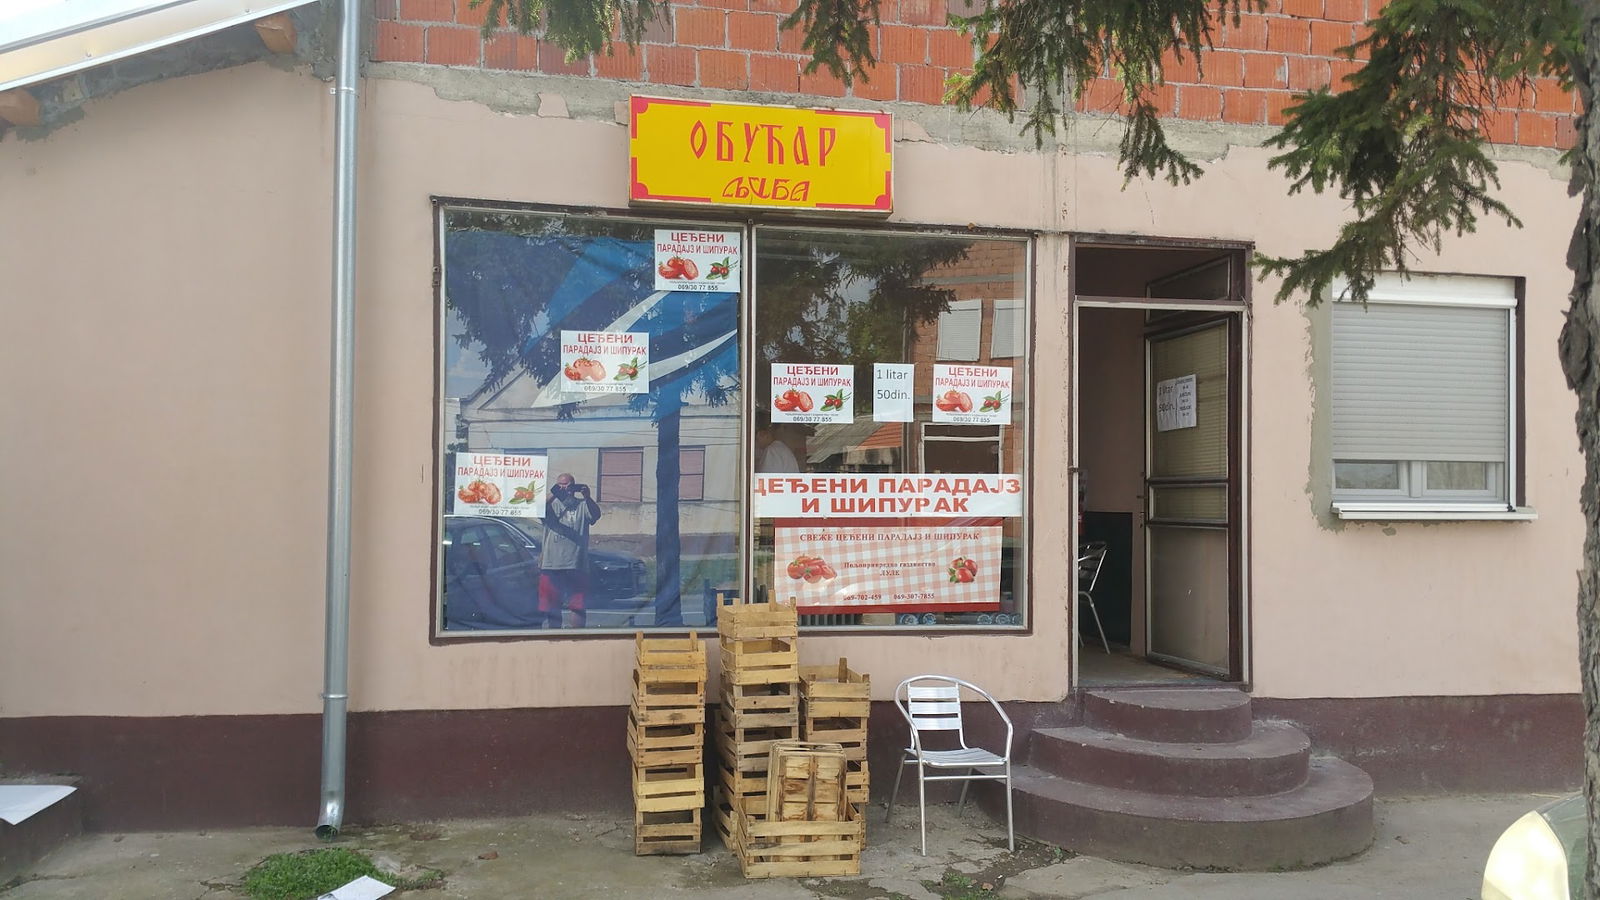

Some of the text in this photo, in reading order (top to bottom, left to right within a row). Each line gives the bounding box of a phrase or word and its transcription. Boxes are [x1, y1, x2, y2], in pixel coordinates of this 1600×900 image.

[690, 120, 836, 166] ОБУЋАР
[671, 232, 724, 244] ЦЕЂЕНИ
[657, 244, 738, 254] ПАРАДАЈЗ И ШИПУРАК
[578, 333, 632, 344] ЦЕЂЕНИ
[563, 345, 647, 355] ПАРАДАЈЗ И ШИПУРАК
[787, 366, 839, 376] ЦЕЂЕНИ
[876, 370, 908, 380] 1 litar
[948, 367, 998, 378] ЦЕЂЕНИ
[774, 377, 809, 387] ПАРАДАЈЗ
[817, 378, 852, 387] ШИПУРАК
[935, 378, 1010, 389] ПАРАДАЈЗ И ШИПУРАК
[877, 389, 910, 400] 50din.
[474, 456, 531, 466] ЦЕЂЕНИ
[458, 467, 545, 479] ПАРАДАЈЗ И ШИПУРАК
[878, 478, 1021, 496] ПАРАДАЈЗ
[801, 497, 969, 513] И ШИПУРАК
[800, 533, 833, 541] СВЕЖЕ
[836, 533, 874, 542] ЦЕЂЕНИ
[878, 533, 922, 541] ПАРАДАЈЗ
[933, 532, 980, 540] ШИПУРАК
